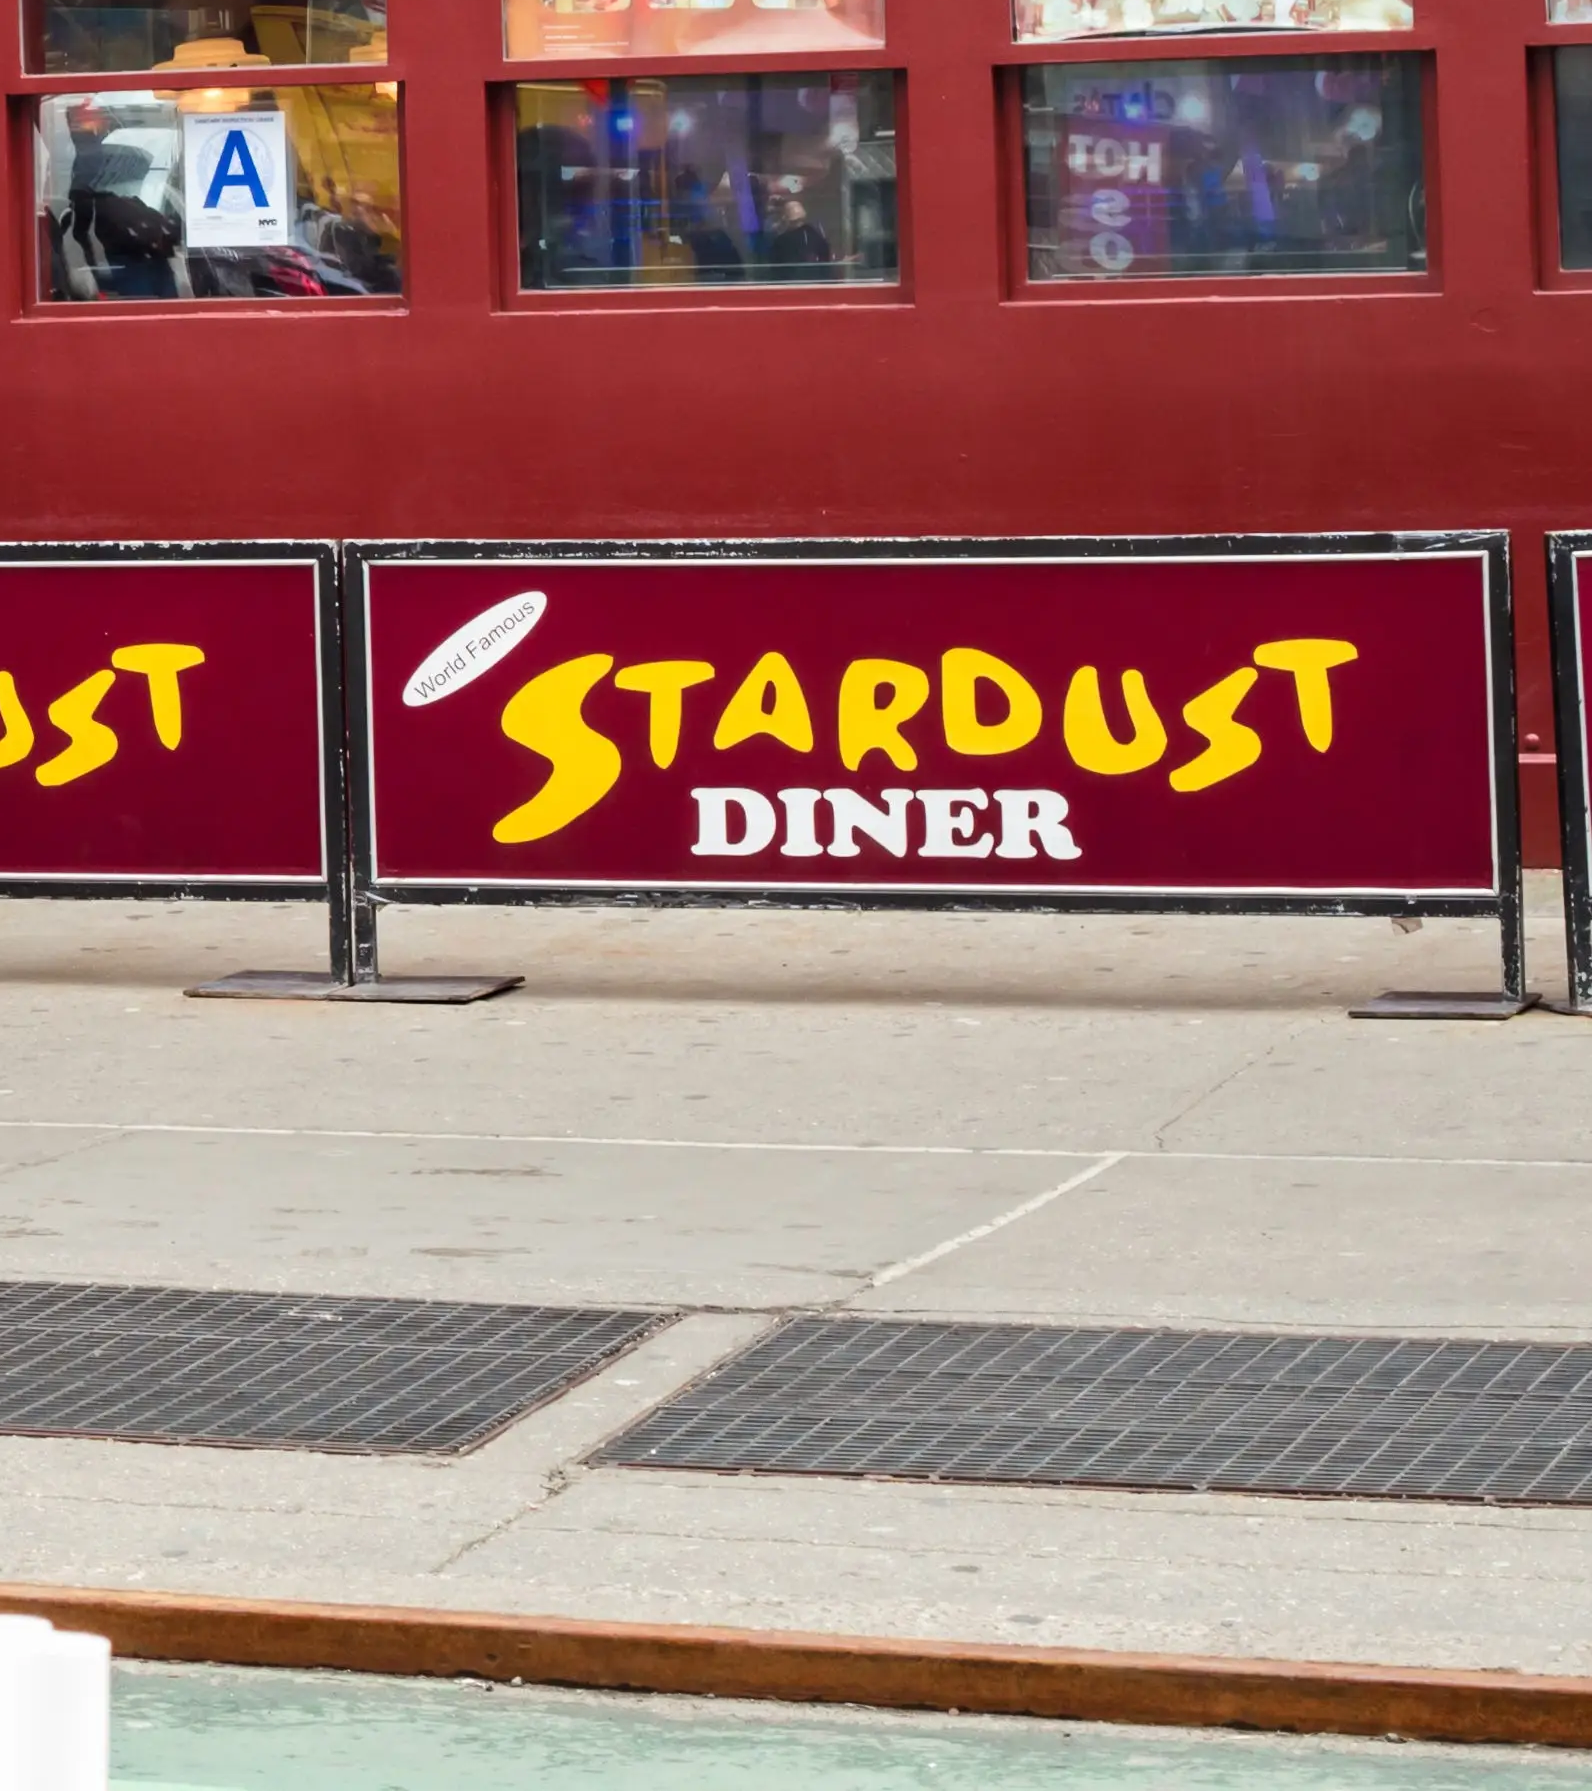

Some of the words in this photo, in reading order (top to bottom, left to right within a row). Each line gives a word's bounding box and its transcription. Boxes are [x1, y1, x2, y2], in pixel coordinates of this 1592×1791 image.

[202, 129, 270, 208] A
[414, 653, 466, 699] World
[465, 601, 535, 659] Famous
[491, 637, 1360, 845] STARDUST
[689, 786, 1083, 862] DINER
